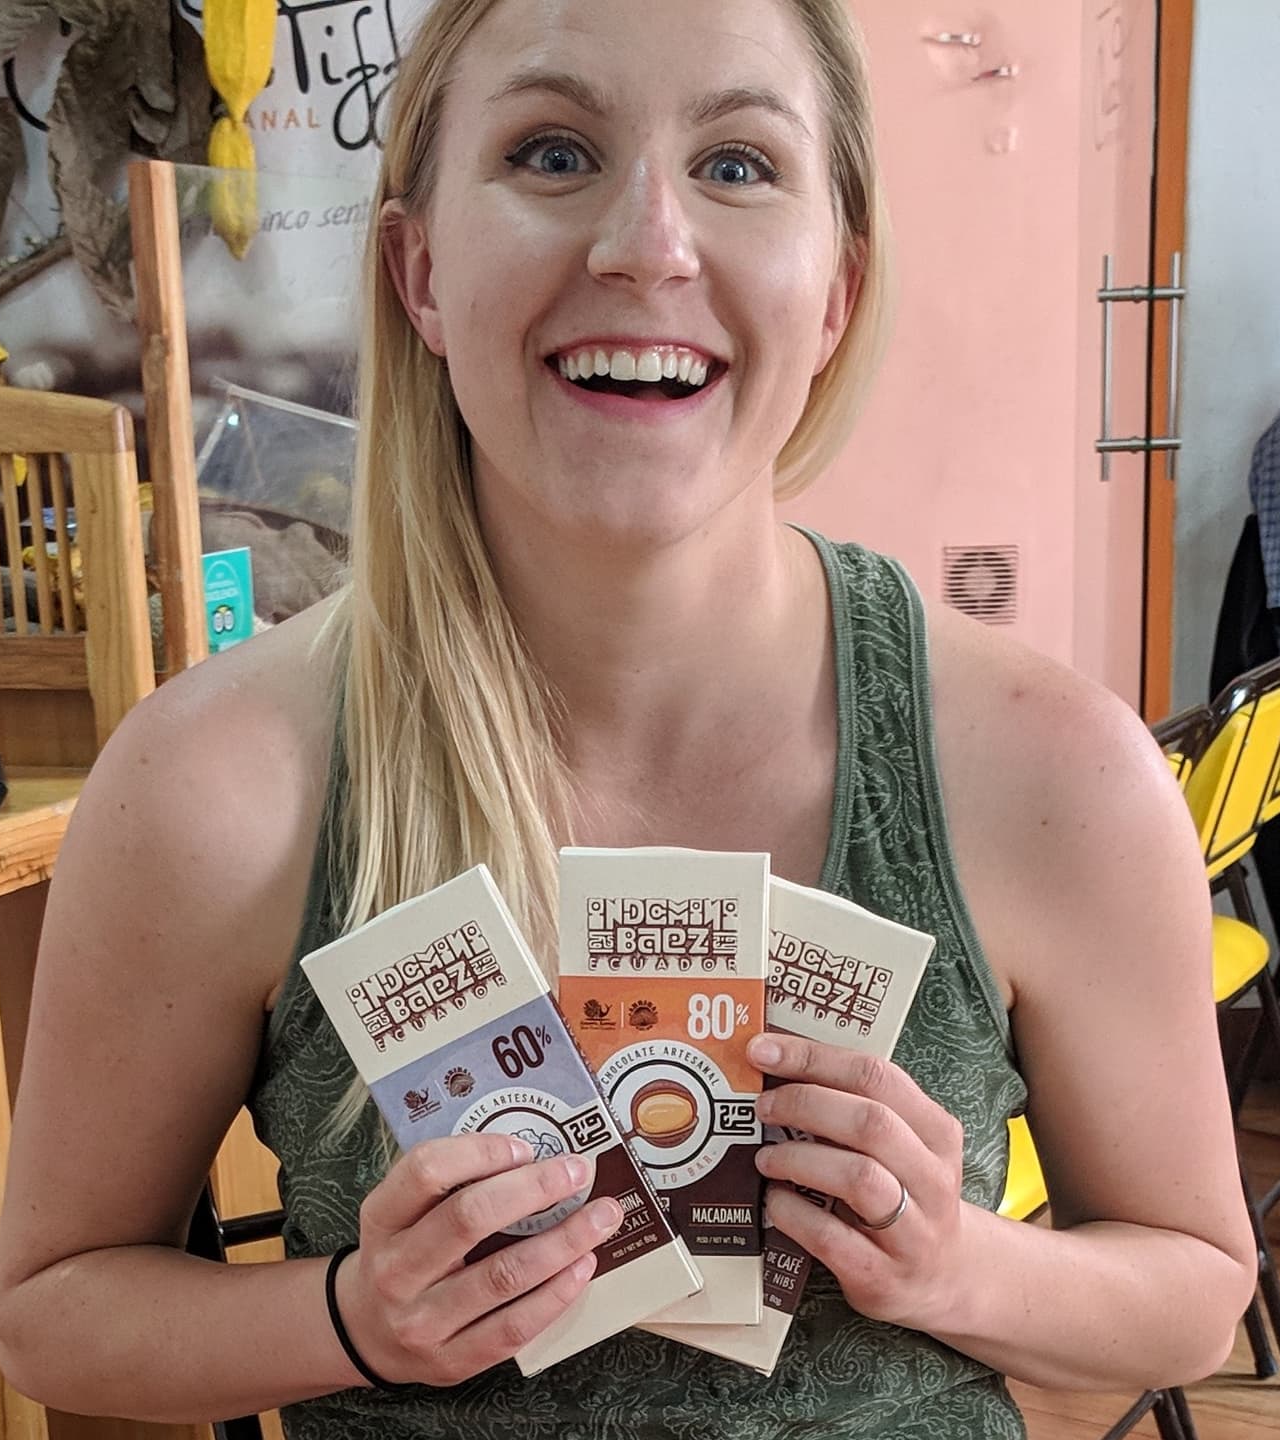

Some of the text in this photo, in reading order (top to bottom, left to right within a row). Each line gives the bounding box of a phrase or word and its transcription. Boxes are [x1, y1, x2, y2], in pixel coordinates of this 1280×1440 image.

[588, 956, 738, 974] ECUADOR
[372, 973, 508, 1053] ECUADOR
[687, 993, 750, 1041] 80%
[770, 990, 872, 1038] UADOR
[491, 1024, 553, 1080] 60%
[601, 1046, 721, 1087] CHOCOLATE ARTESANAL
[493, 1092, 557, 1113] ARTESANAL
[619, 1192, 645, 1214] RINA
[624, 1210, 651, 1231] SALT
[691, 1206, 753, 1225] MACADAMIA
[767, 1251, 805, 1275] DE CAFÉ
[772, 1272, 797, 1290] NIBS
